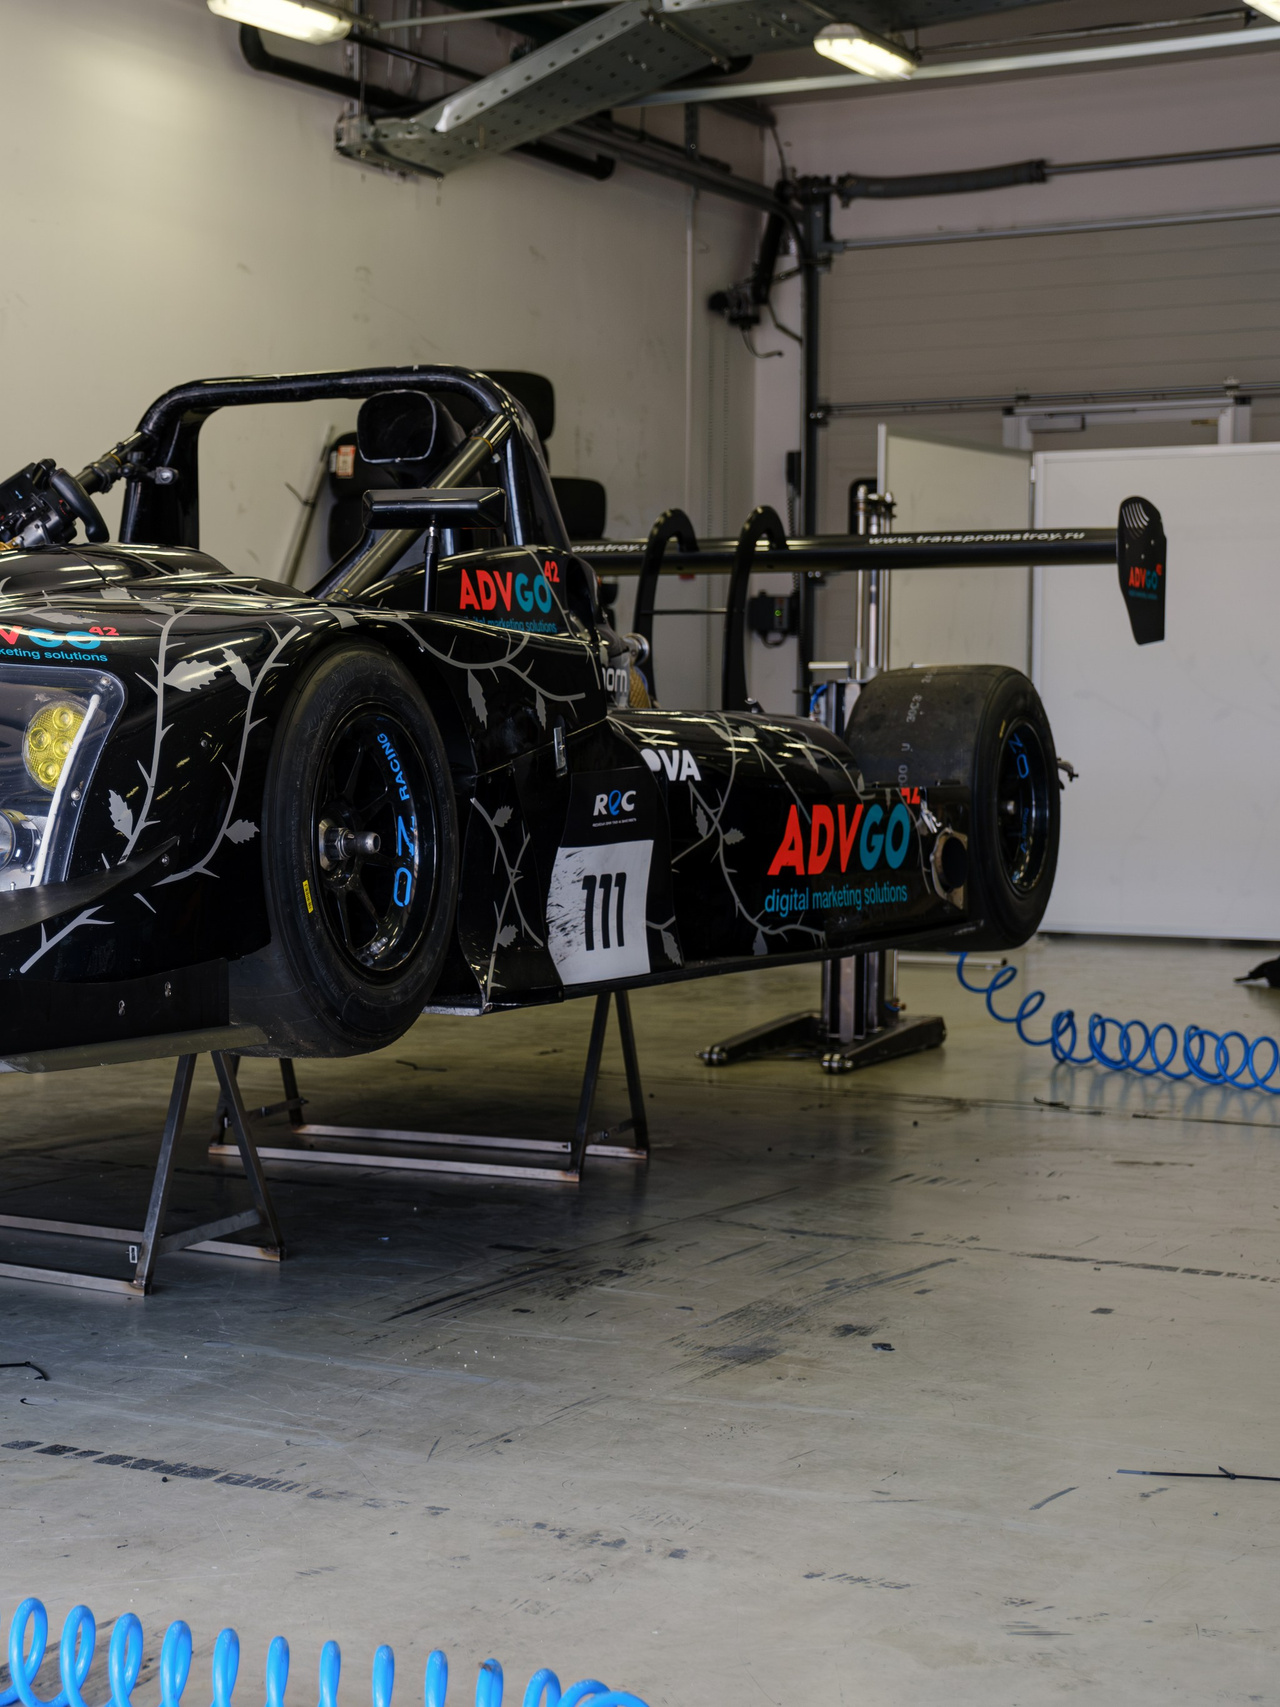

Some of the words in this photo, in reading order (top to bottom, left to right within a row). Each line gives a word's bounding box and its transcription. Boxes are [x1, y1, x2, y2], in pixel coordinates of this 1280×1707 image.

[869, 532, 1085, 544] www.transpromstroy.ru
[44, 651, 108, 662] solutions
[376, 732, 411, 801] RACING
[581, 872, 627, 951] 111
[764, 887, 809, 918] digital
[812, 884, 862, 910] marketing
[864, 881, 908, 905] solutions
